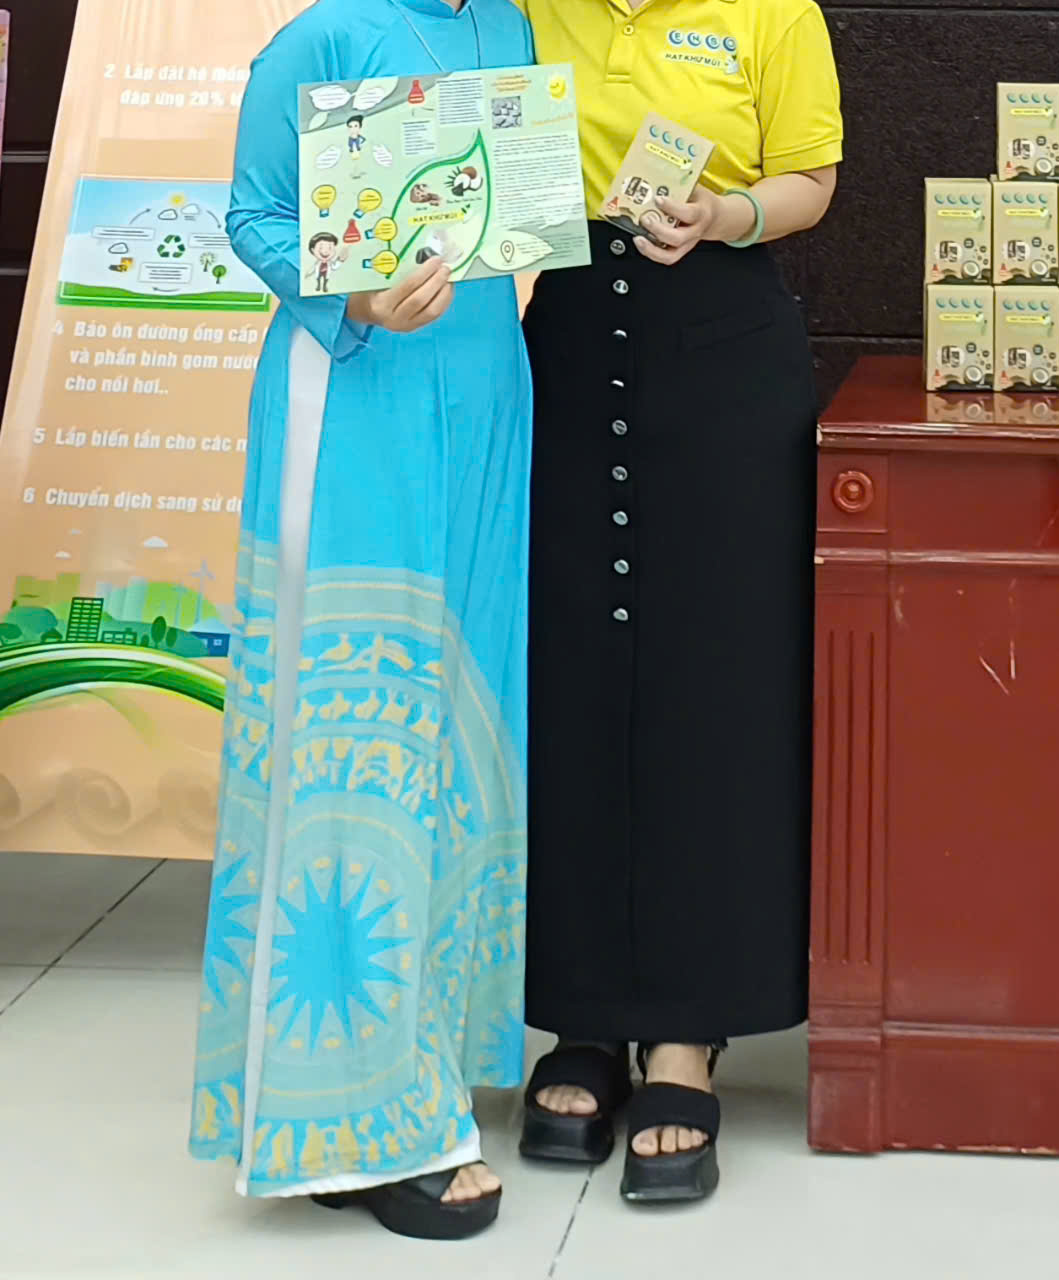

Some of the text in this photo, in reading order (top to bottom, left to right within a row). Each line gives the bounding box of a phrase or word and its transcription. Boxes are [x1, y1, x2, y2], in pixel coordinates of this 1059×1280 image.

[74, 320, 107, 338] Bảo
[137, 323, 189, 342] đường
[193, 323, 224, 343] ống
[228, 323, 258, 344] cấp
[70, 348, 91, 364] và
[182, 353, 218, 370] gom
[65, 376, 97, 392] cho
[33, 427, 46, 444] 5
[91, 428, 130, 448] biến
[165, 433, 197, 451] cho
[201, 433, 232, 452] các
[23, 487, 36, 504] 6
[46, 485, 110, 508] Chuyển
[114, 491, 153, 511] dịch
[156, 495, 198, 513] sang
